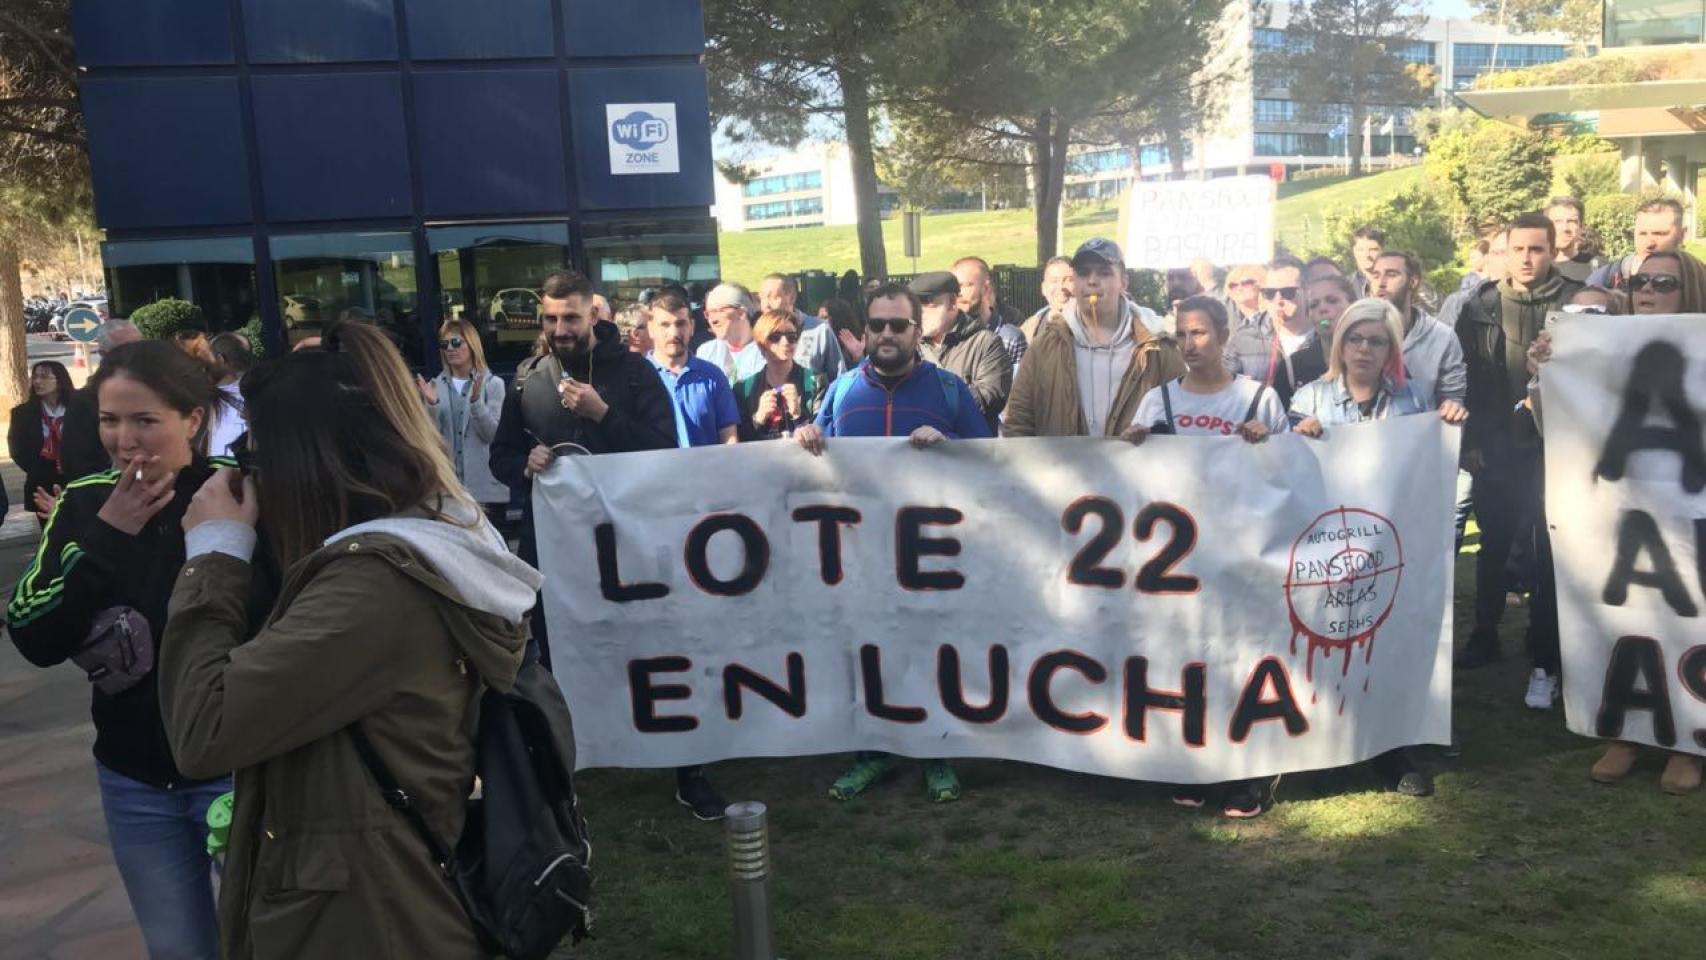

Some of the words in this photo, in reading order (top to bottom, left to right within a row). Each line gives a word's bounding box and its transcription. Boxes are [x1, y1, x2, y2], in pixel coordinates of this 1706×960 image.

[625, 152, 660, 164] ZONE
[1144, 231, 1258, 265] BASURA
[1307, 524, 1384, 545] AUTOGRILL
[594, 504, 966, 602] LOTE
[1061, 495, 1200, 596] 22
[1295, 550, 1384, 580] PANSFOOD
[1324, 587, 1377, 609] AREAS
[1329, 615, 1374, 634] SERHS
[627, 651, 806, 733] EN
[860, 643, 1310, 750] LUCHA
